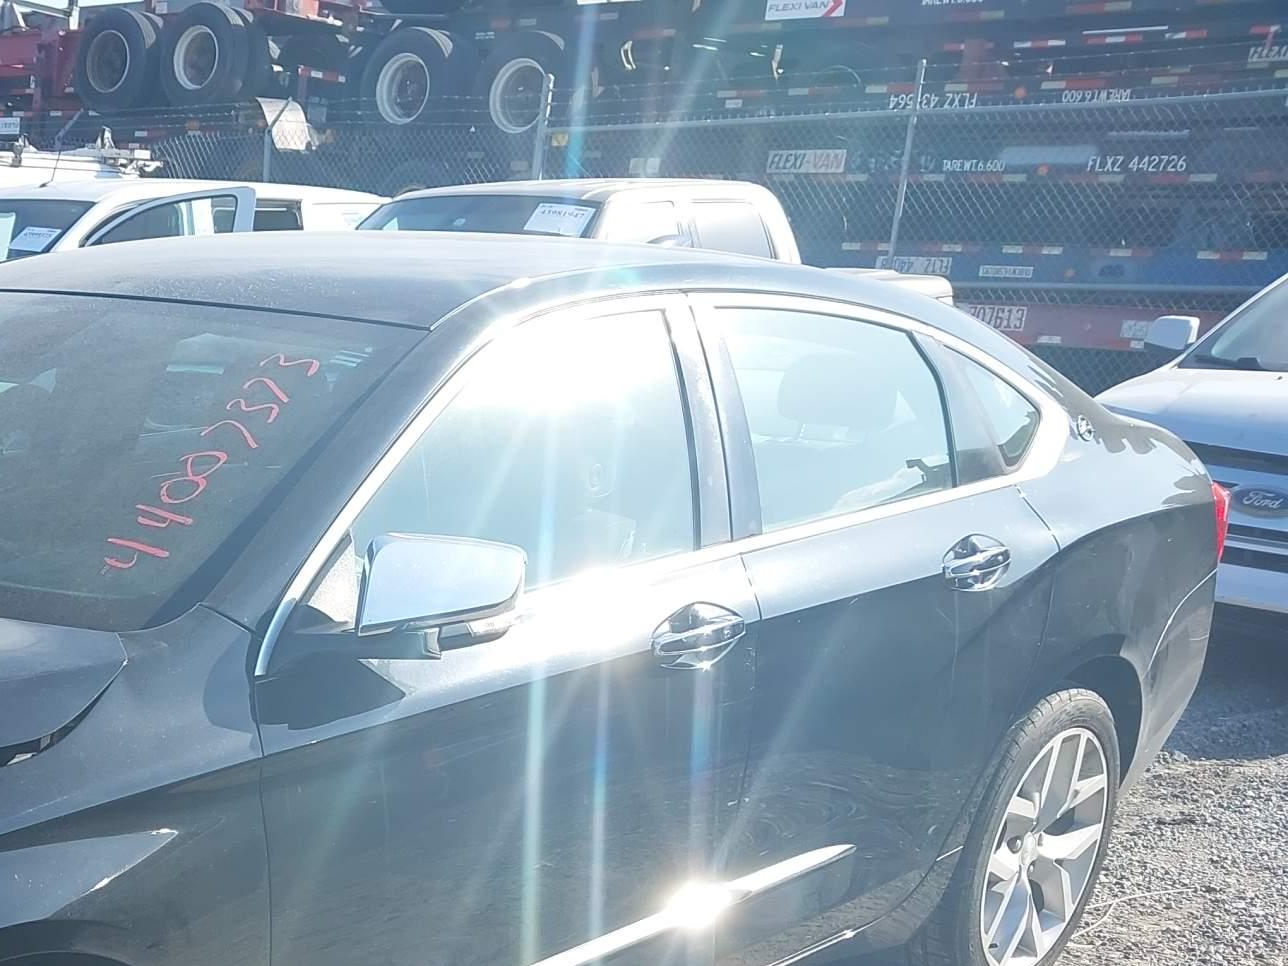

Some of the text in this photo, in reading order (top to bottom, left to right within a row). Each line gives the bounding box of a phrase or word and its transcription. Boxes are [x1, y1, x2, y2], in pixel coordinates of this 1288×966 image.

[768, 1, 831, 12] FLEXI VAN
[888, 92, 939, 109] 43564
[1086, 155, 1187, 172] FLXZ 442726
[1243, 490, 1284, 509] Ford
